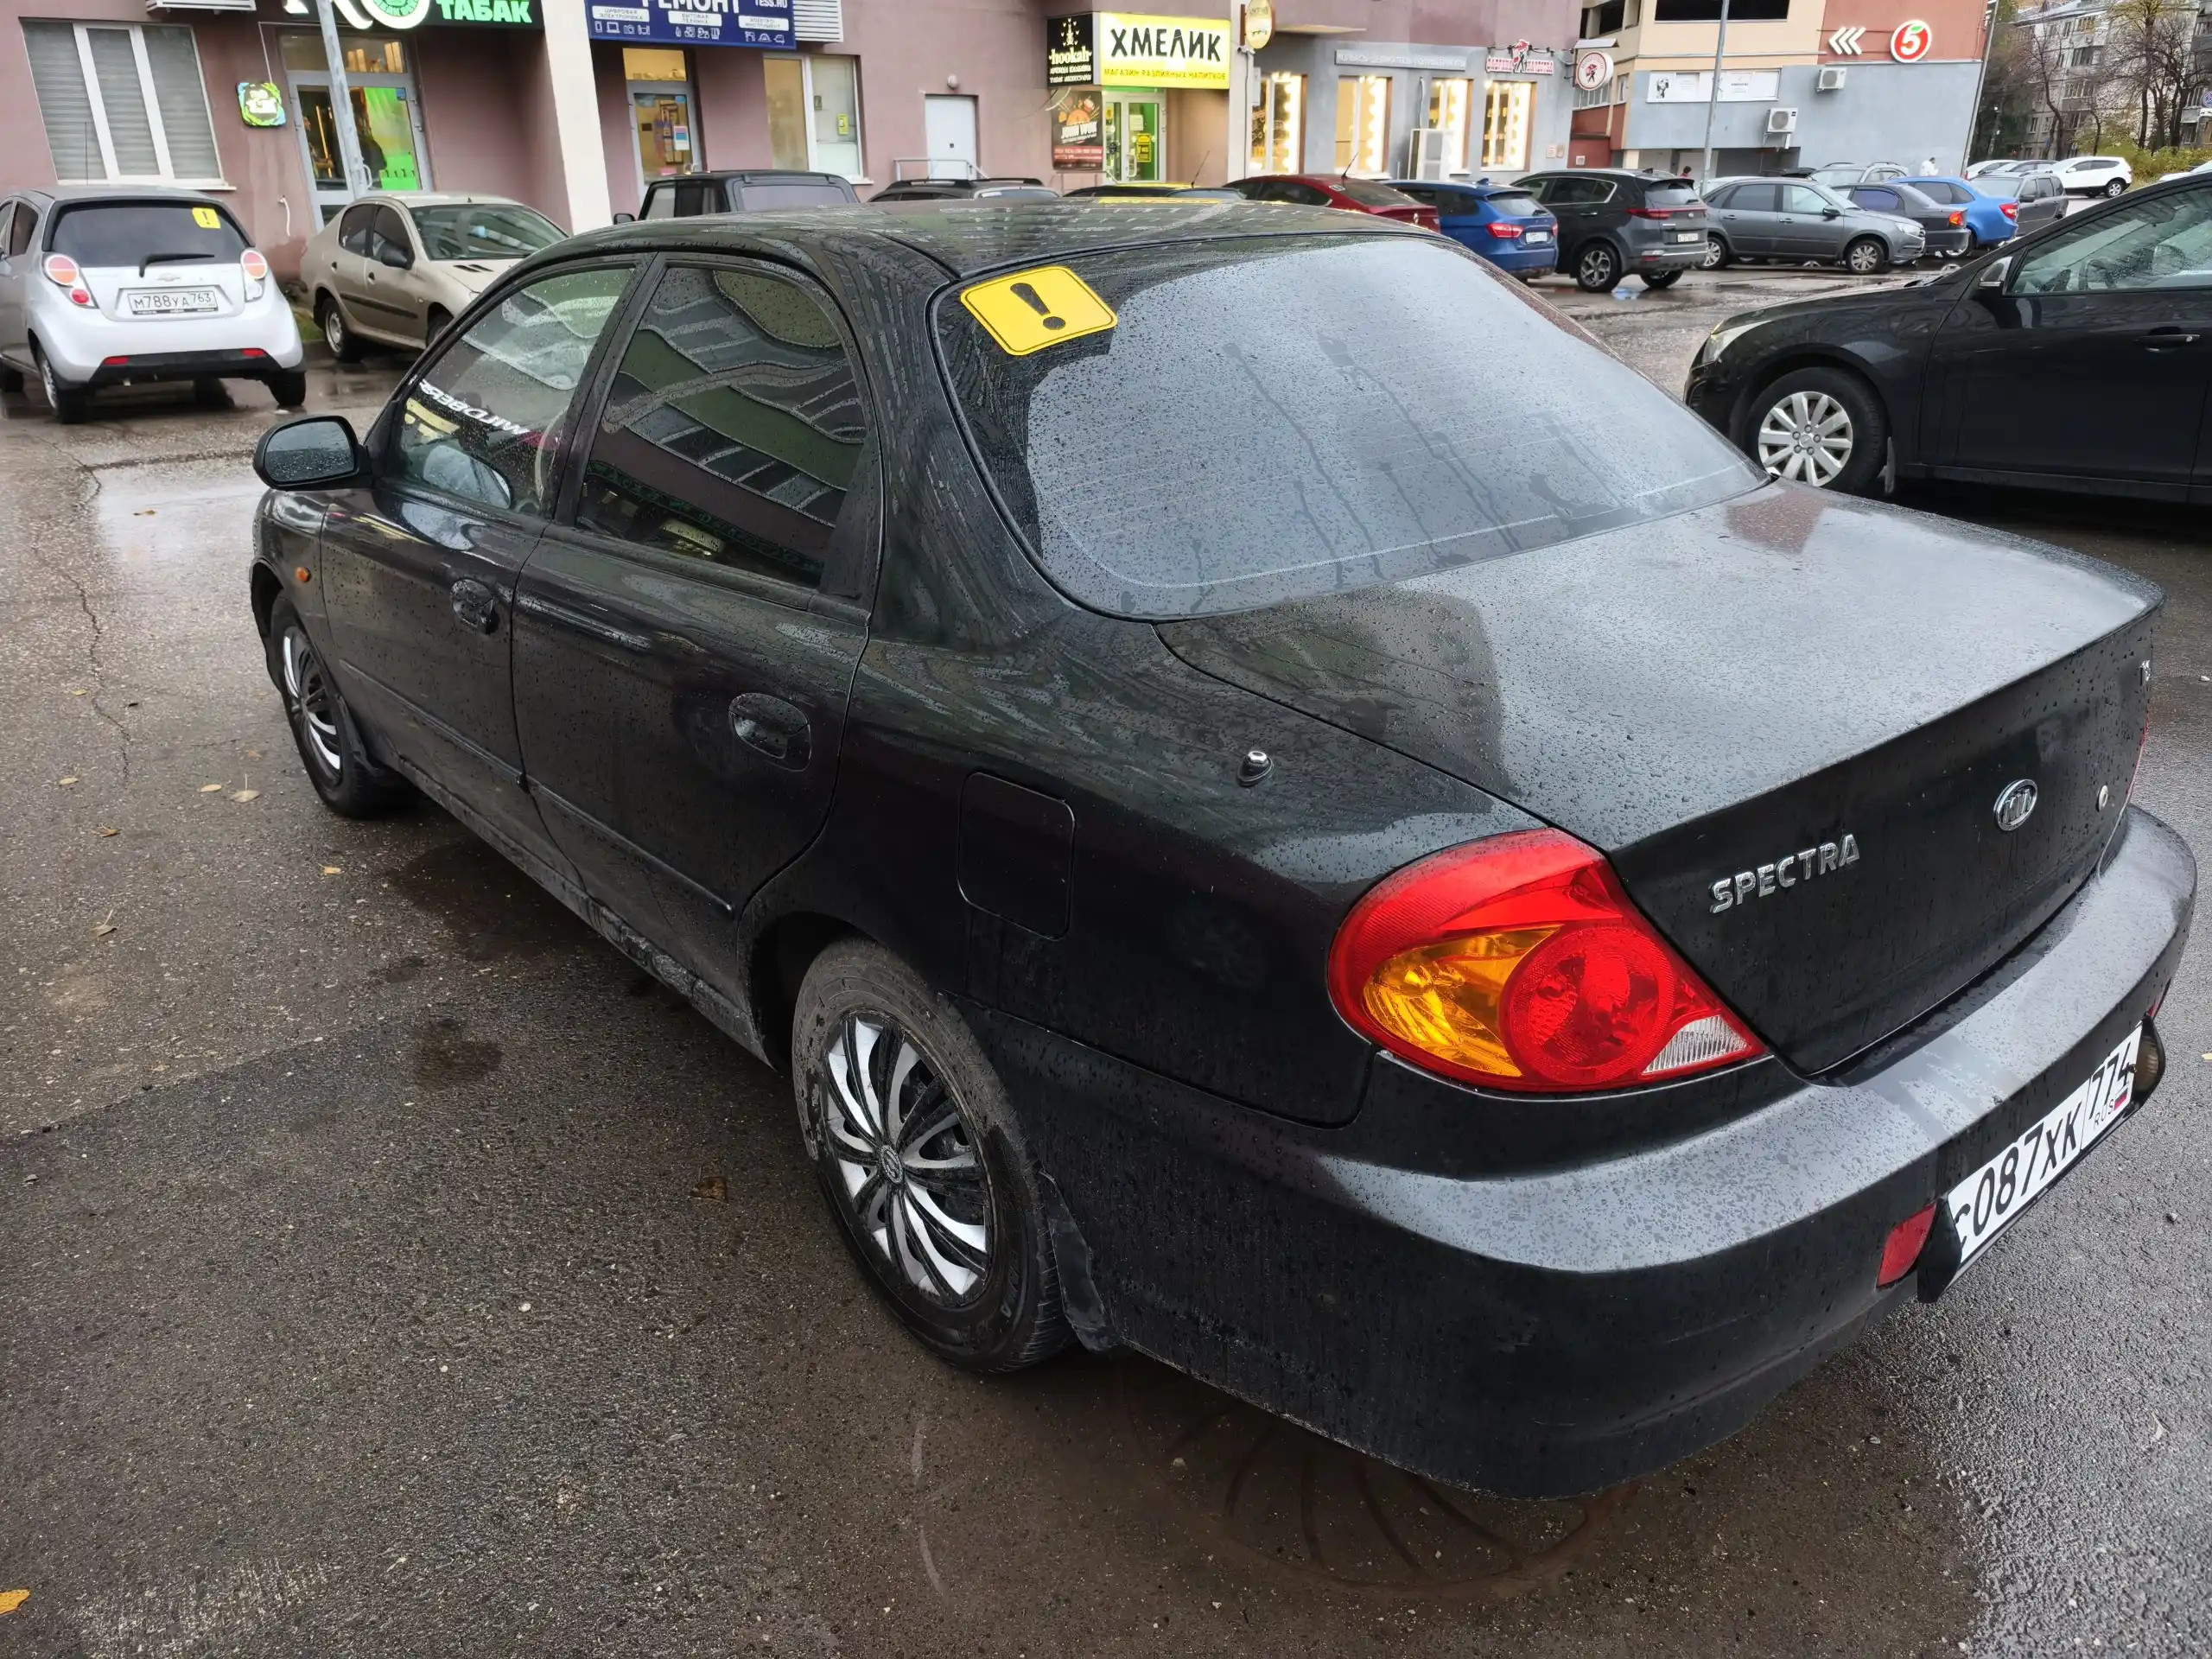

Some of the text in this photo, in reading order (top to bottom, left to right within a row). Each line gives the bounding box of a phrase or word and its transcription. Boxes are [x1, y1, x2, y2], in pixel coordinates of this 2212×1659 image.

[439, 0, 533, 23] ТАБАК
[1051, 45, 1090, 65] hookah
[1110, 27, 1221, 62] ХМЕЛИК
[1104, 68, 1226, 80] МАГАЗИН РАЗЛИВНЫХ НАПИТКОВ
[190, 292, 212, 303] 763
[1710, 834, 1860, 913] SPECTRA
[2094, 1098, 2114, 1130] RUS
